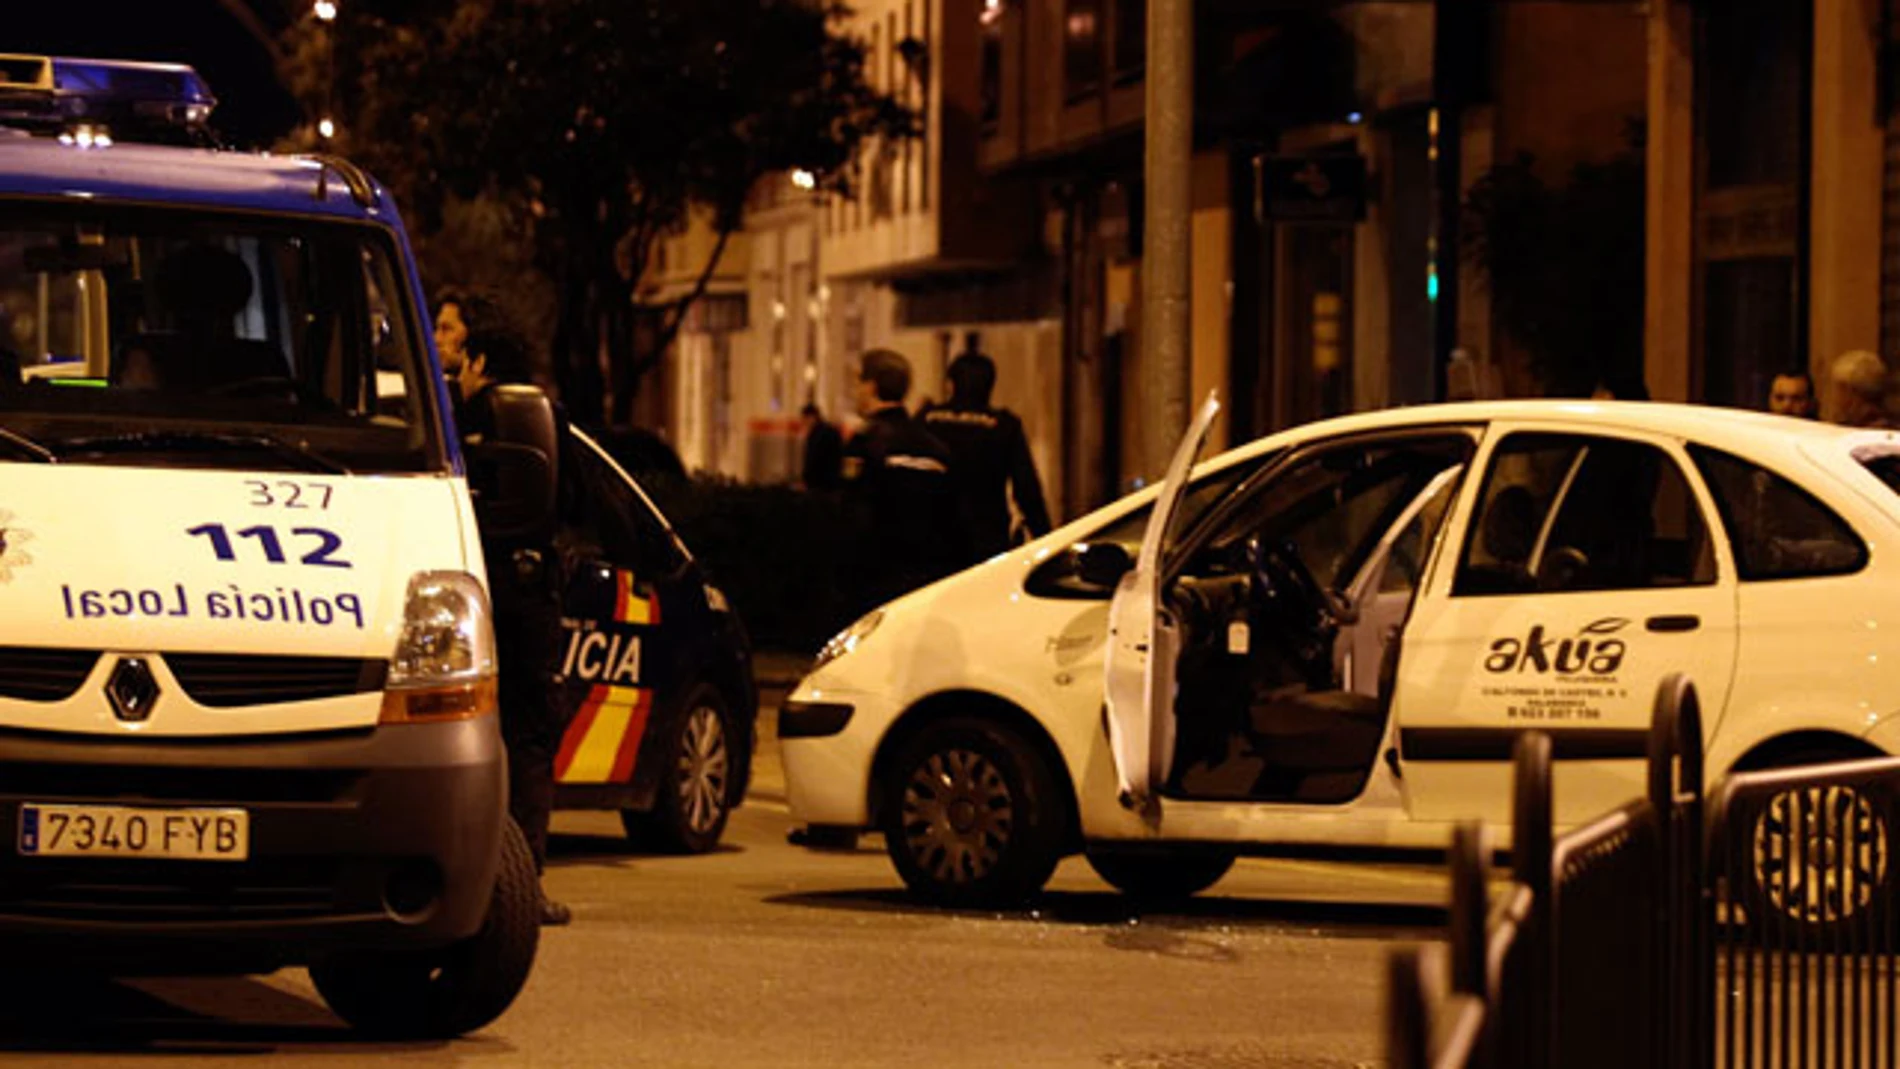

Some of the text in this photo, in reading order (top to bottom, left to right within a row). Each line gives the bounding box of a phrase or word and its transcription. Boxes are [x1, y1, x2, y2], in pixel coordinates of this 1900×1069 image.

[244, 480, 333, 510] 327
[186, 522, 353, 569] 112
[553, 631, 642, 683] ICIA
[48, 813, 237, 852] 7340 FYB
